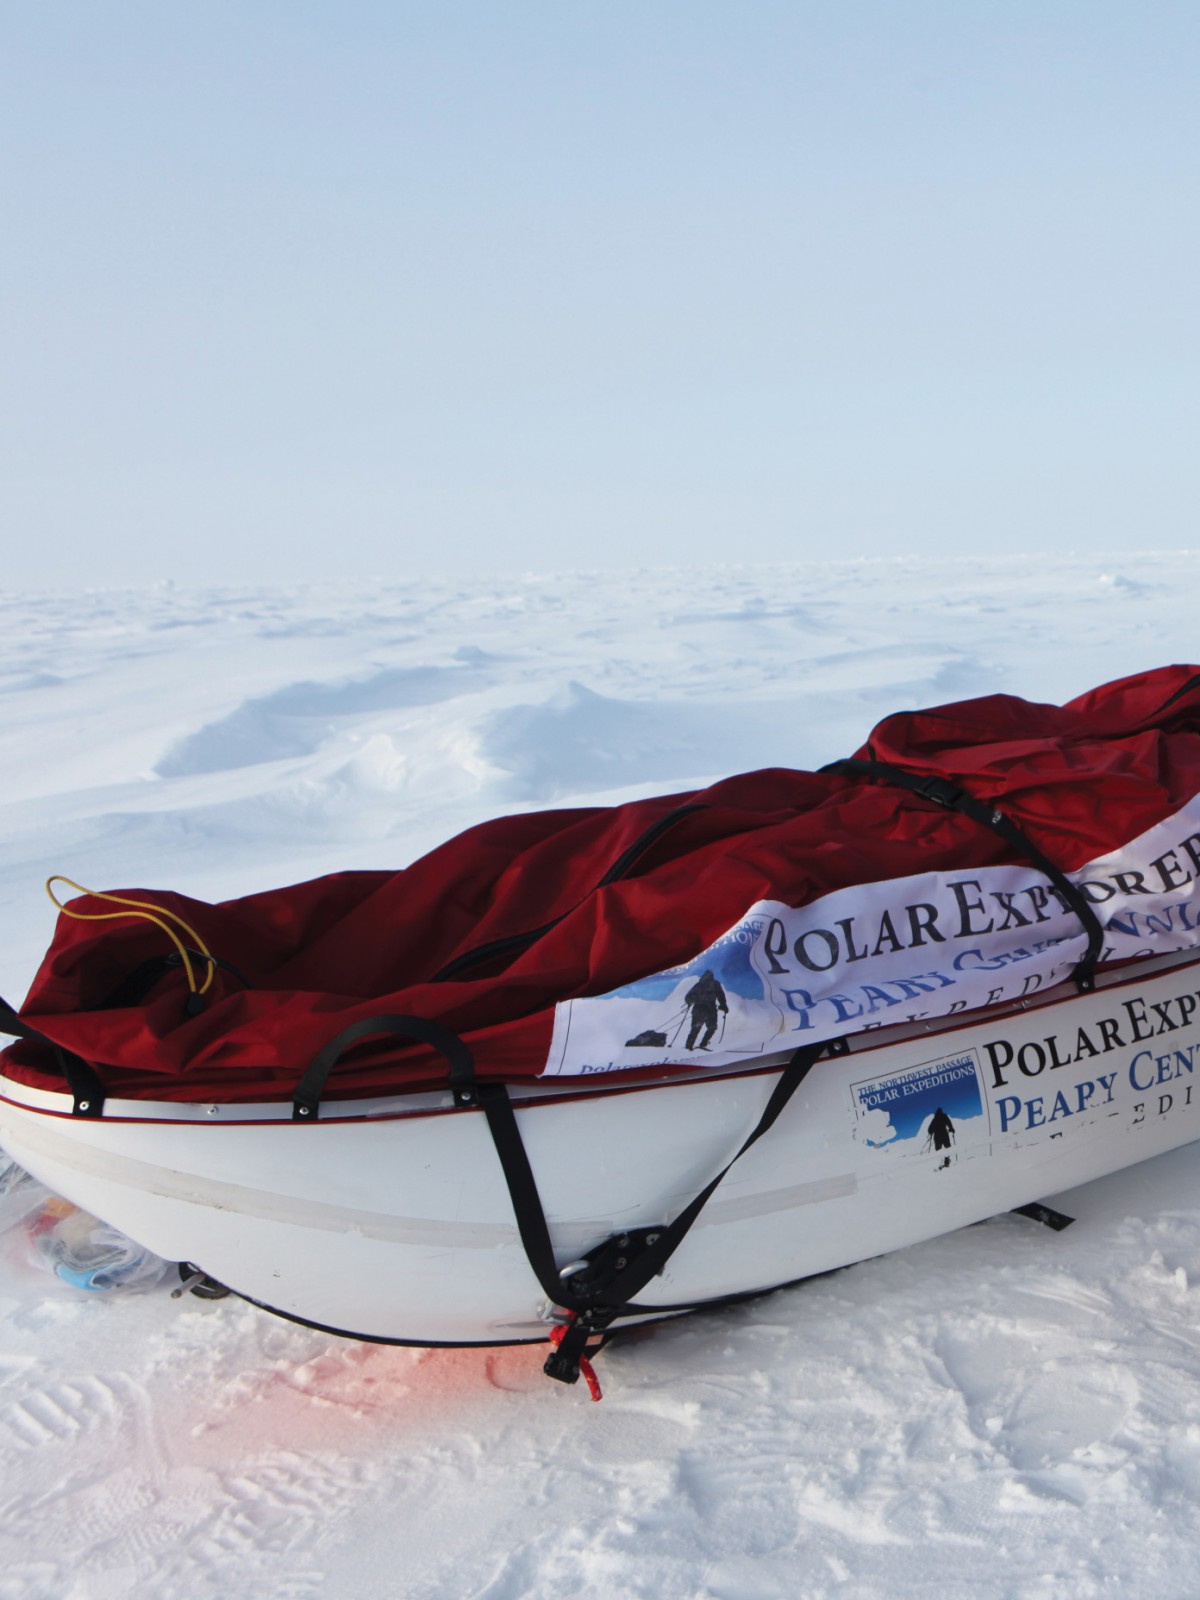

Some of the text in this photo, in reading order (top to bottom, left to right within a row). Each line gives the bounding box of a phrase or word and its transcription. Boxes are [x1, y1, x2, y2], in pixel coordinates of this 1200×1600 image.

[858, 1055, 973, 1097] THE NORTHWEST PASSAGE
[859, 1064, 976, 1107] POLAR EXPEDITIONS
